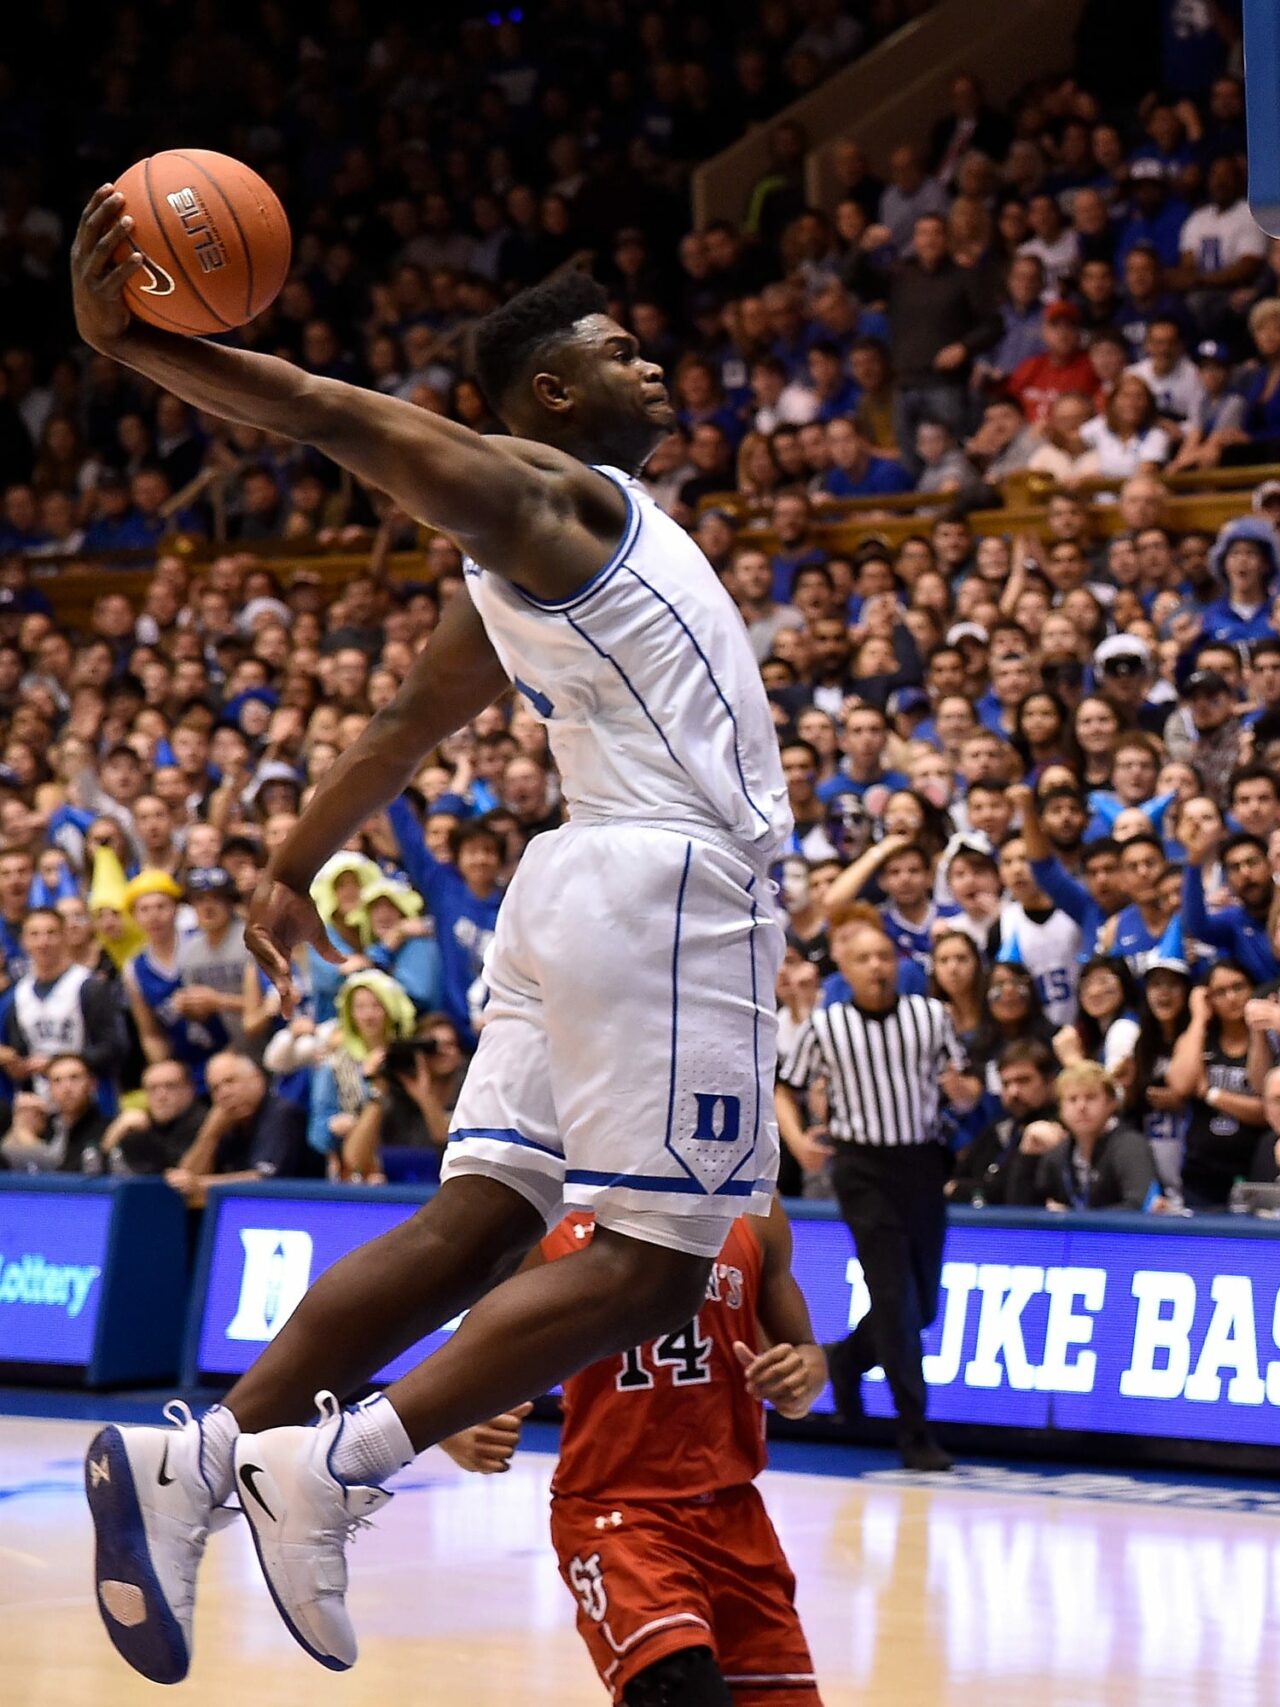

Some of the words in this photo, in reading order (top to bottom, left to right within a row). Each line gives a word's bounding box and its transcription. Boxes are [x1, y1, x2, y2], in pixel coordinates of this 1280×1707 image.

[166, 187, 226, 274] ELITE
[691, 1092, 741, 1142] D
[0, 1252, 101, 1319] ottery
[225, 1228, 313, 1342] D
[616, 1314, 714, 1393] 14
